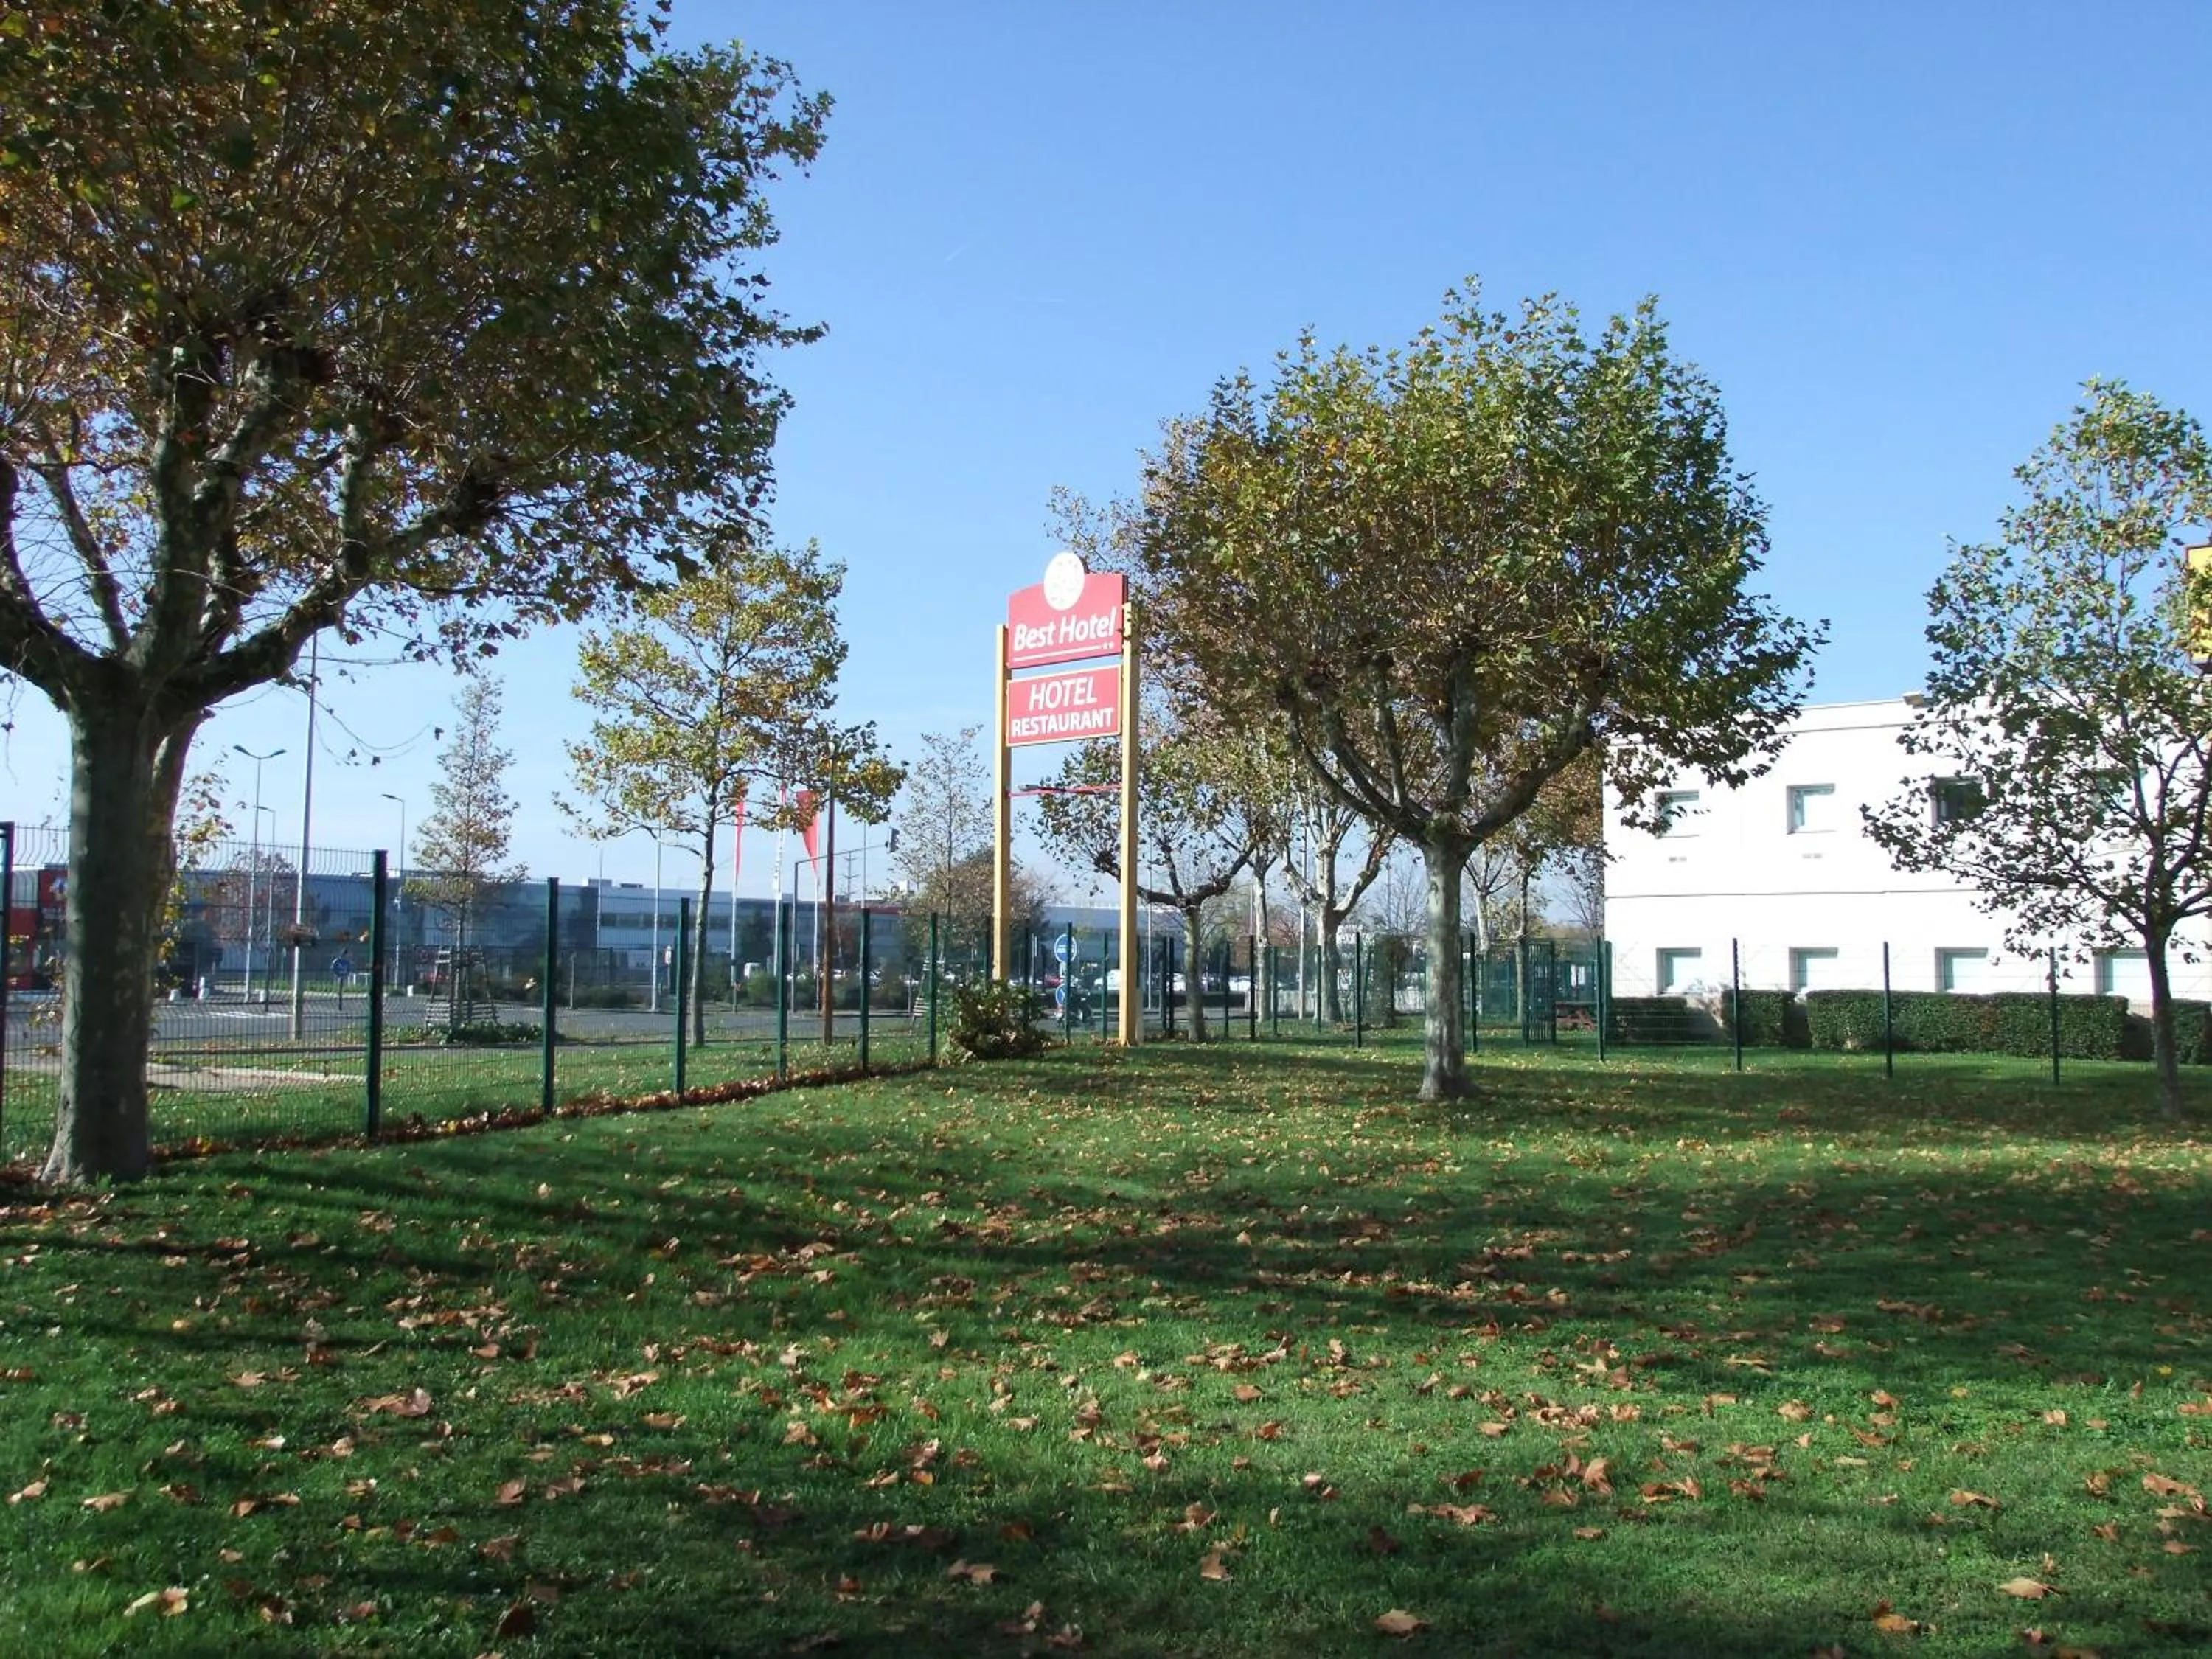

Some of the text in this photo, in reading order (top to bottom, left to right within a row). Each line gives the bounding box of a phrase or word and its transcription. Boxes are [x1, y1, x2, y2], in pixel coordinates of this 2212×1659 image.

[1014, 606, 1117, 651] Best Hotel
[1029, 676, 1097, 711] HOTEL
[1011, 707, 1114, 737] RESTAURANT
